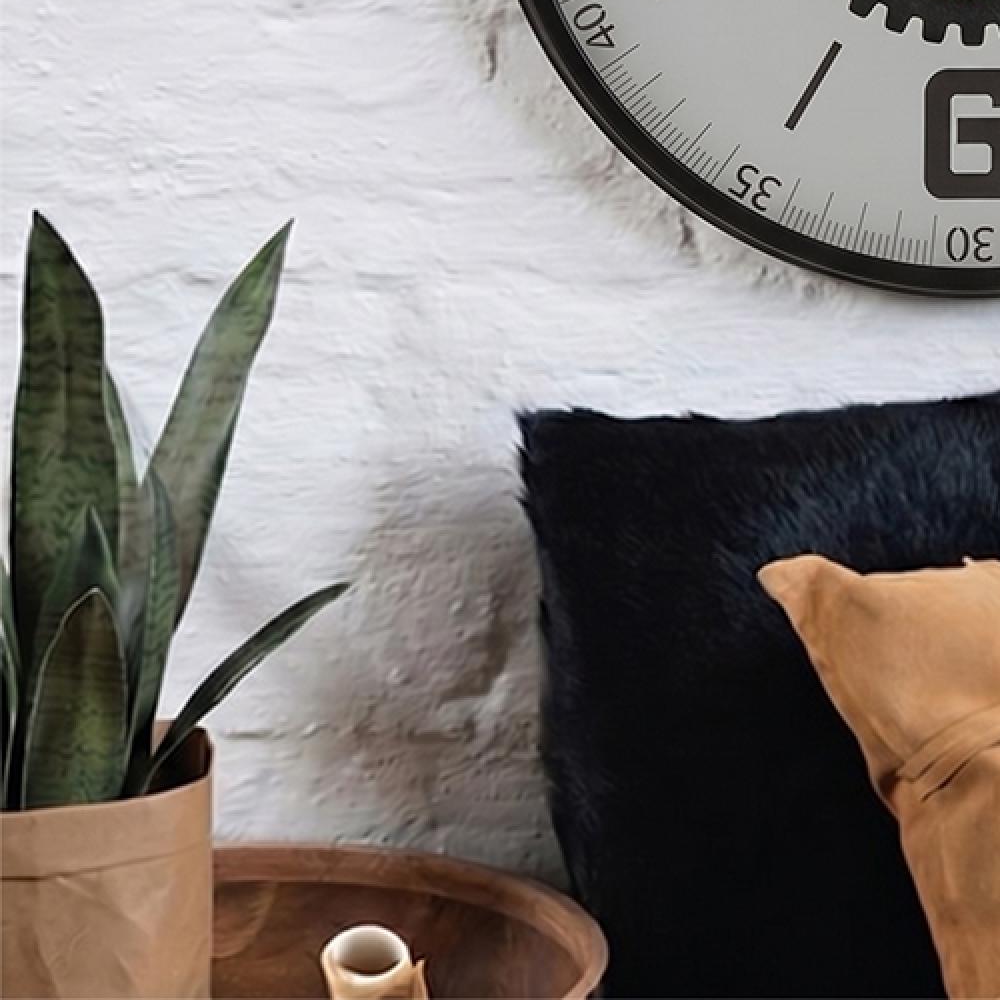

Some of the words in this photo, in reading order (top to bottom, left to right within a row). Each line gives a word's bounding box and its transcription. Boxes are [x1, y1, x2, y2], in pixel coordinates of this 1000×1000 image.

[572, 4, 616, 49] 40
[728, 164, 783, 212] 35
[946, 226, 995, 263] 30
